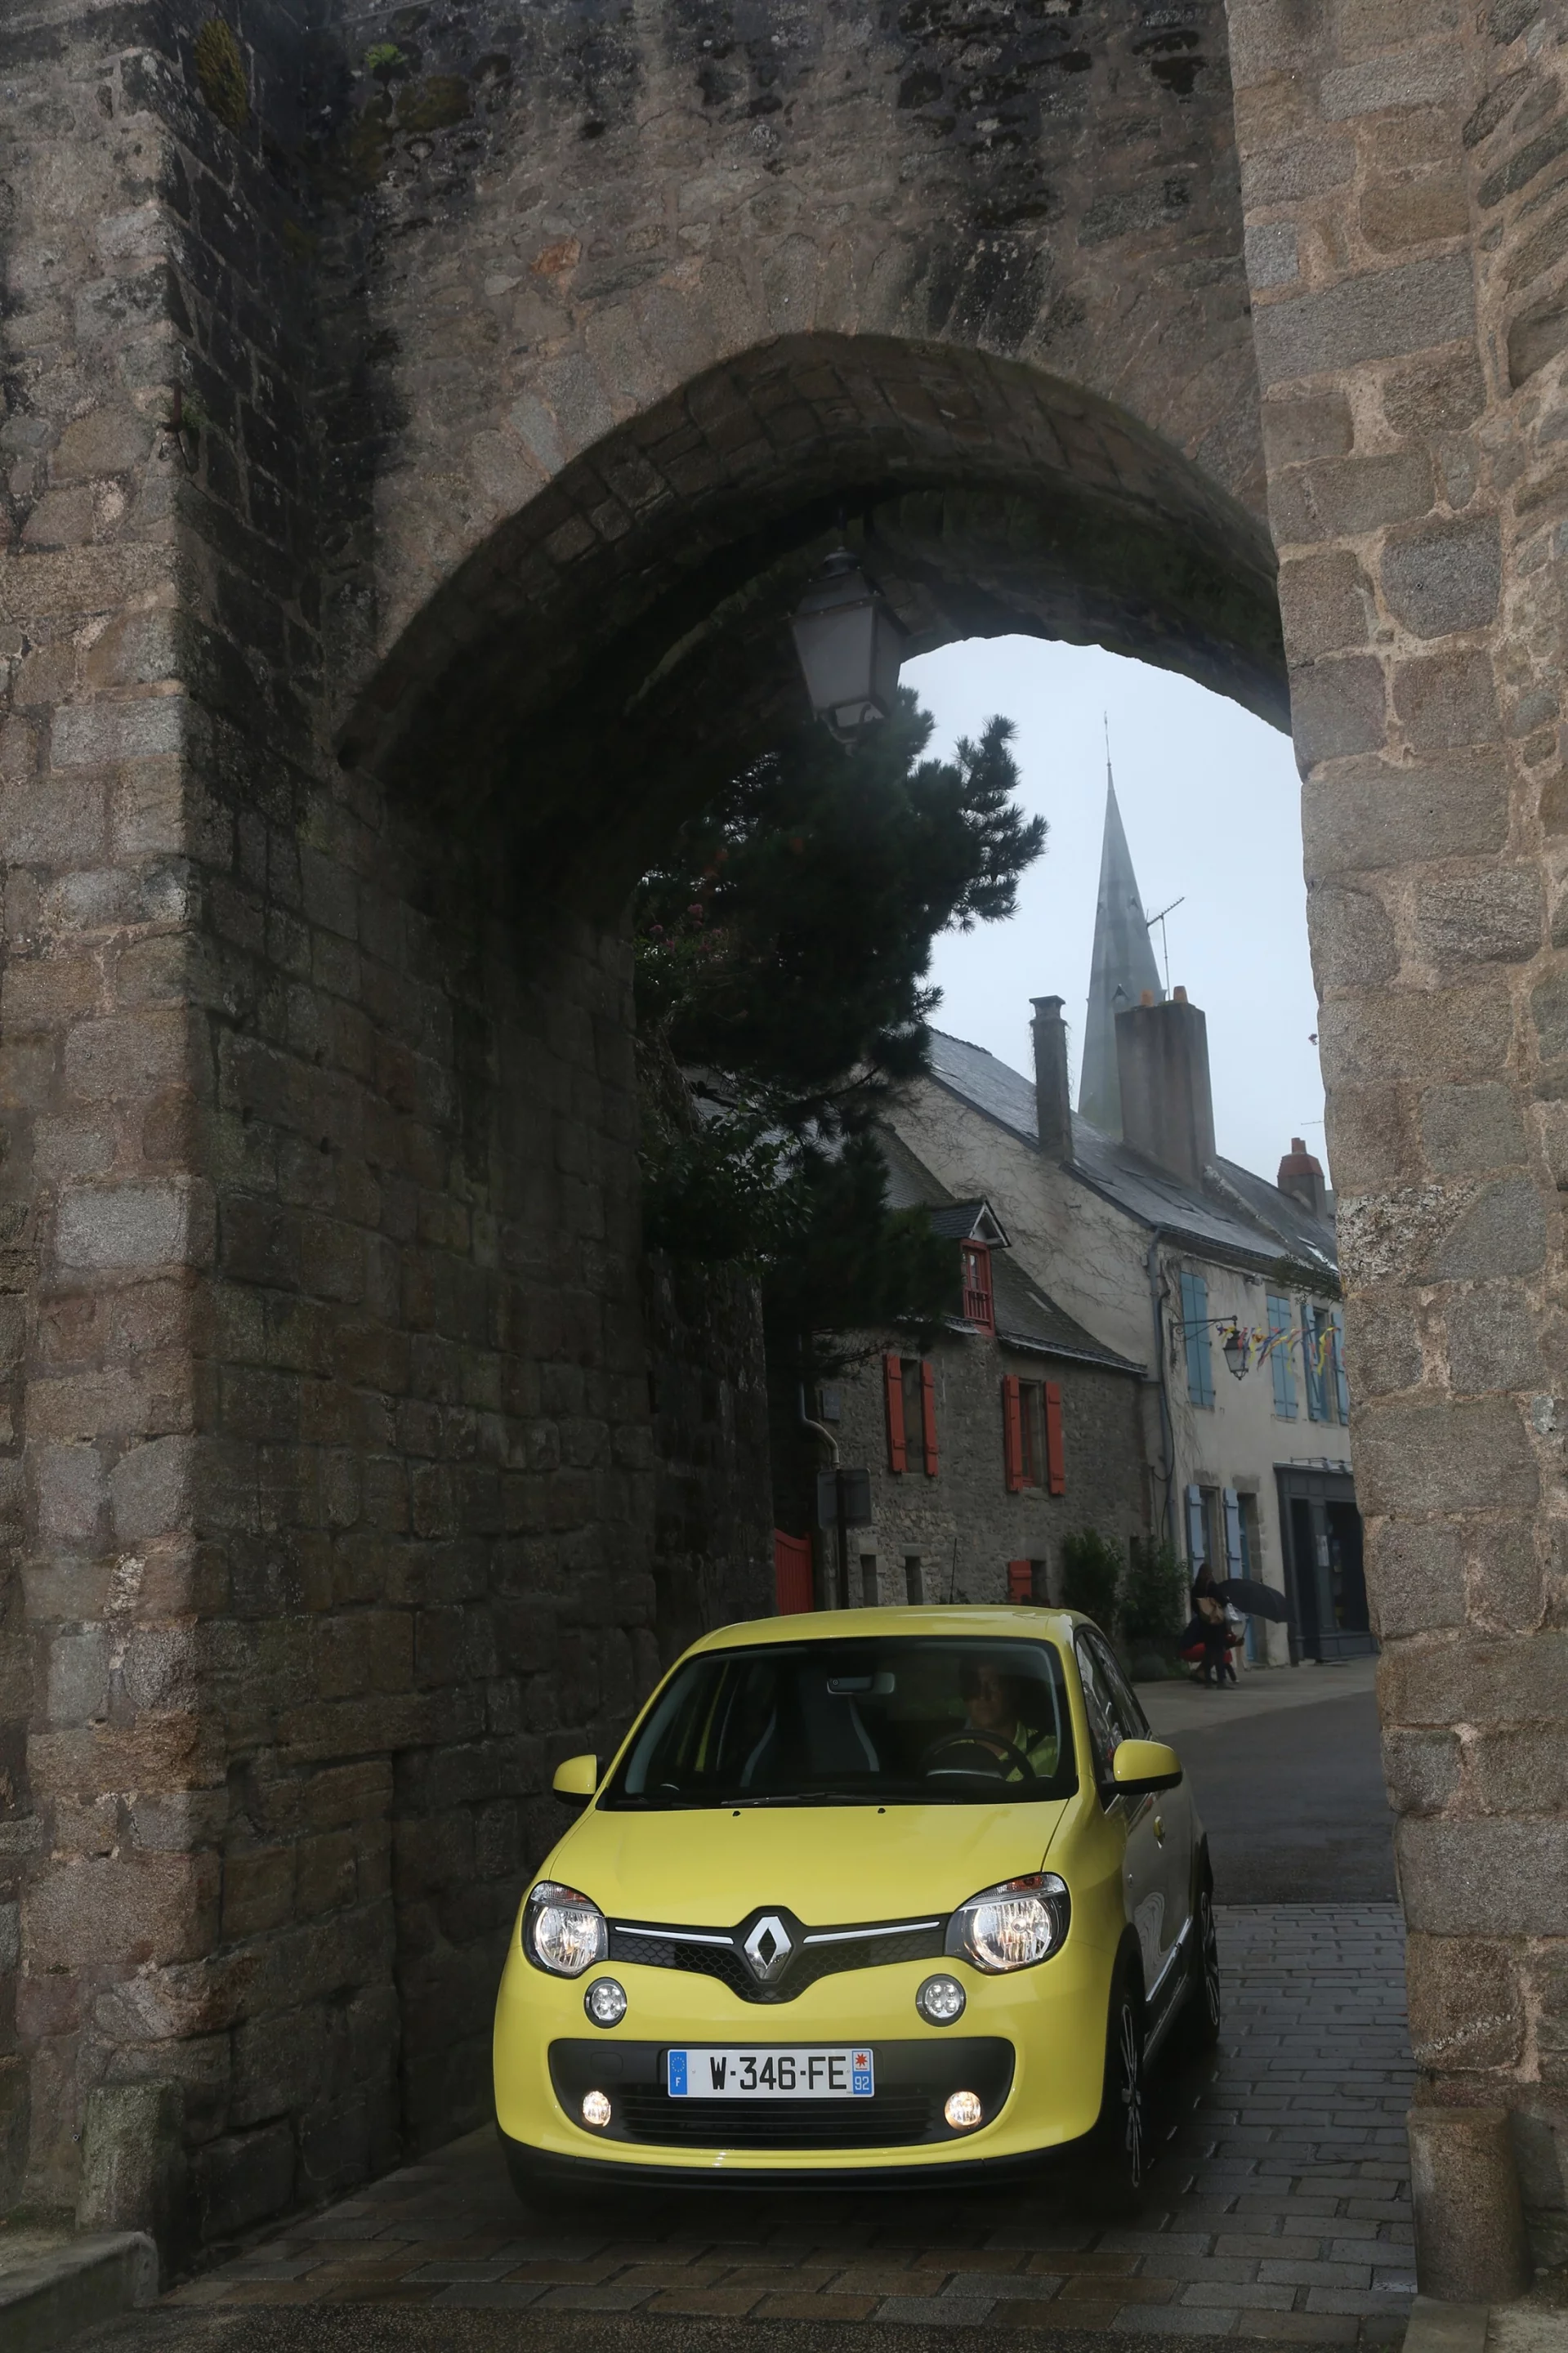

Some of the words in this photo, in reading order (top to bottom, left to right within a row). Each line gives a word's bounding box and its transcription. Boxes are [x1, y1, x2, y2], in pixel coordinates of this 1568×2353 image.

[710, 2056, 847, 2090] W-346-FE
[675, 2077, 681, 2087] F
[855, 2076, 869, 2091] 92
